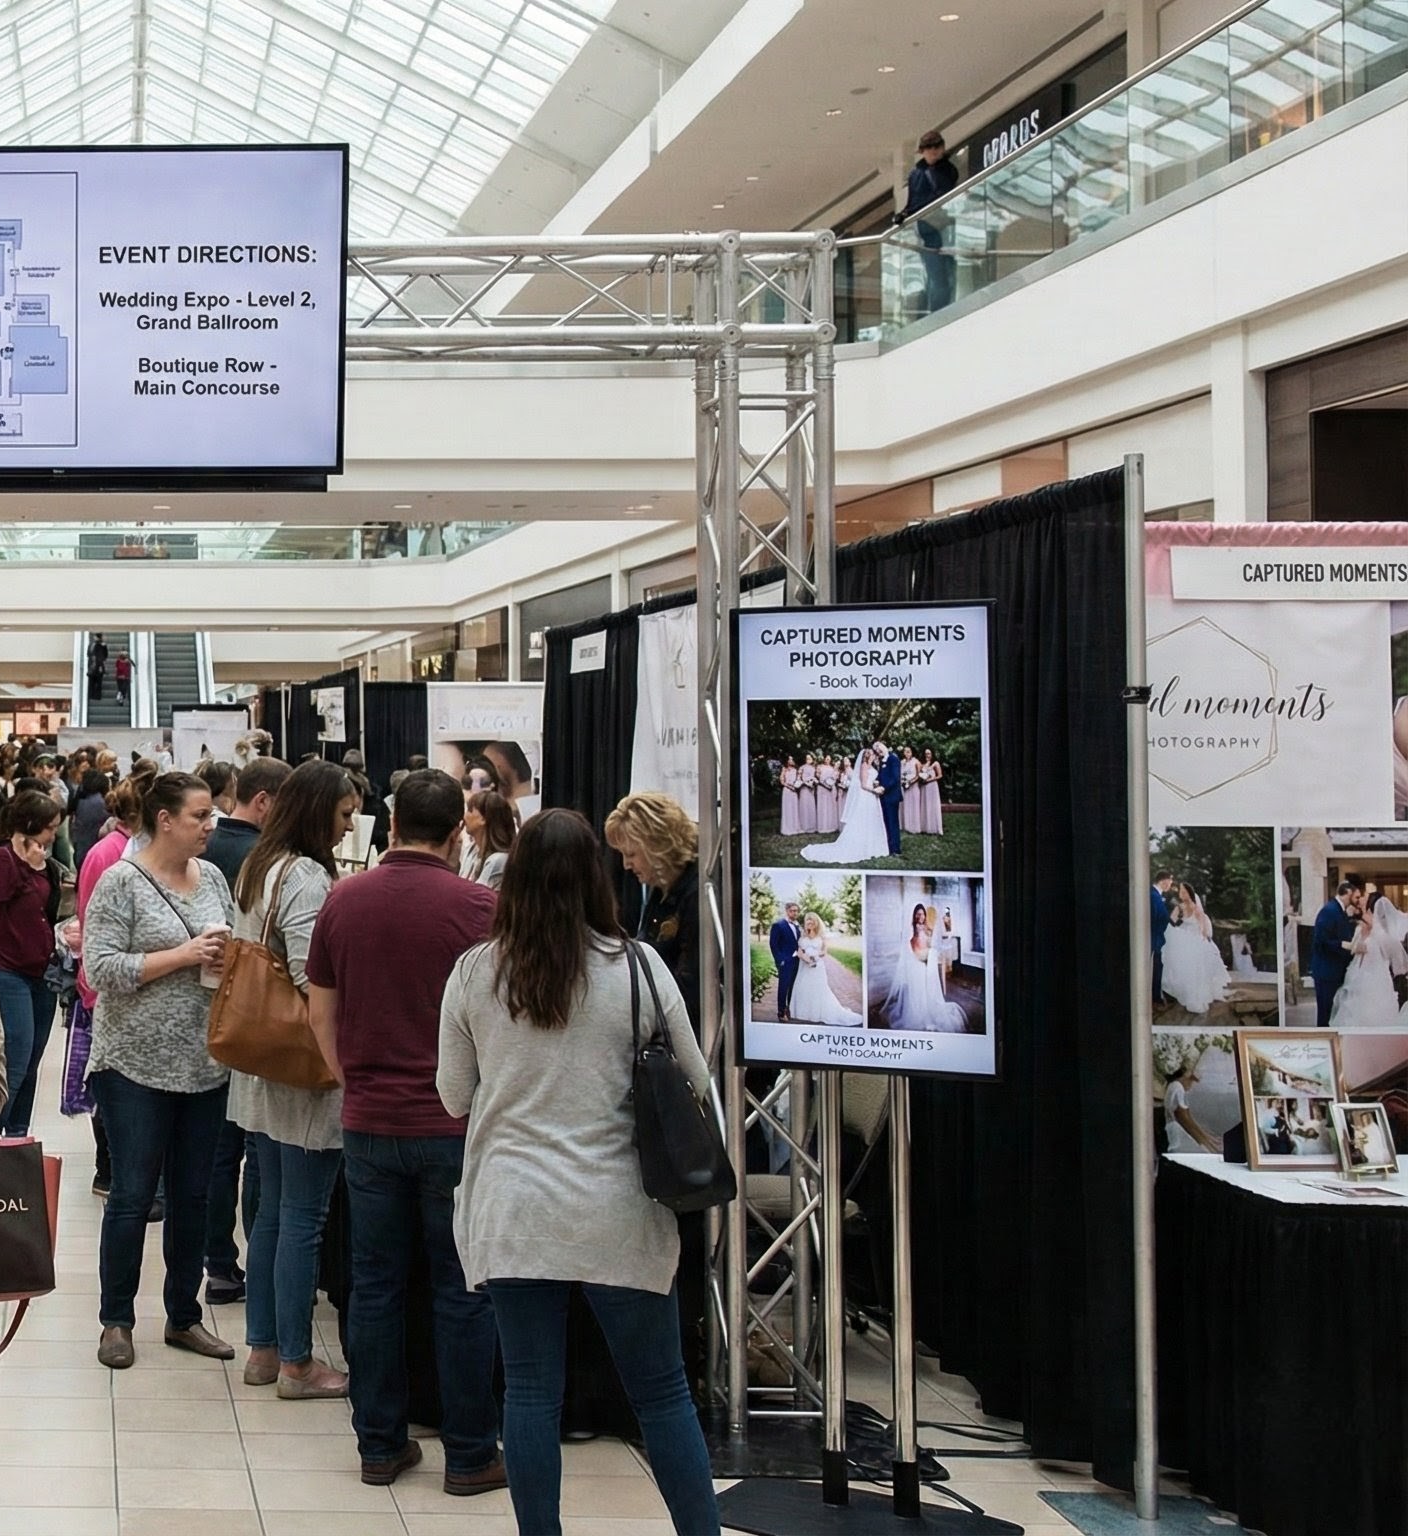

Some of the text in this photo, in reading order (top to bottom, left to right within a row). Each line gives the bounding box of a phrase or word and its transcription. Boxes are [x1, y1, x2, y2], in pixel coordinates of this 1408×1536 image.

[99, 245, 317, 264] EVENT DIRECTIONS:
[99, 291, 178, 311] Wedding
[184, 291, 230, 311] Expo
[247, 291, 295, 307] Level
[300, 291, 316, 310] 2,
[136, 314, 279, 330] Grand Ballroom
[138, 357, 219, 376] Boutique
[225, 358, 265, 373] Row
[134, 380, 280, 395] Main Concourse
[1242, 563, 1408, 583] CAPTURED MOMENTS
[760, 624, 965, 646] CAPTURED MOMENTS
[789, 649, 935, 668] PHOTOGRAPHY
[820, 675, 858, 689] Book
[863, 674, 912, 691] Today!
[1183, 682, 1334, 721] moments
[1148, 737, 1260, 749] HOTOGRAPHY
[799, 1032, 934, 1051] CAPTURED MOMENTS
